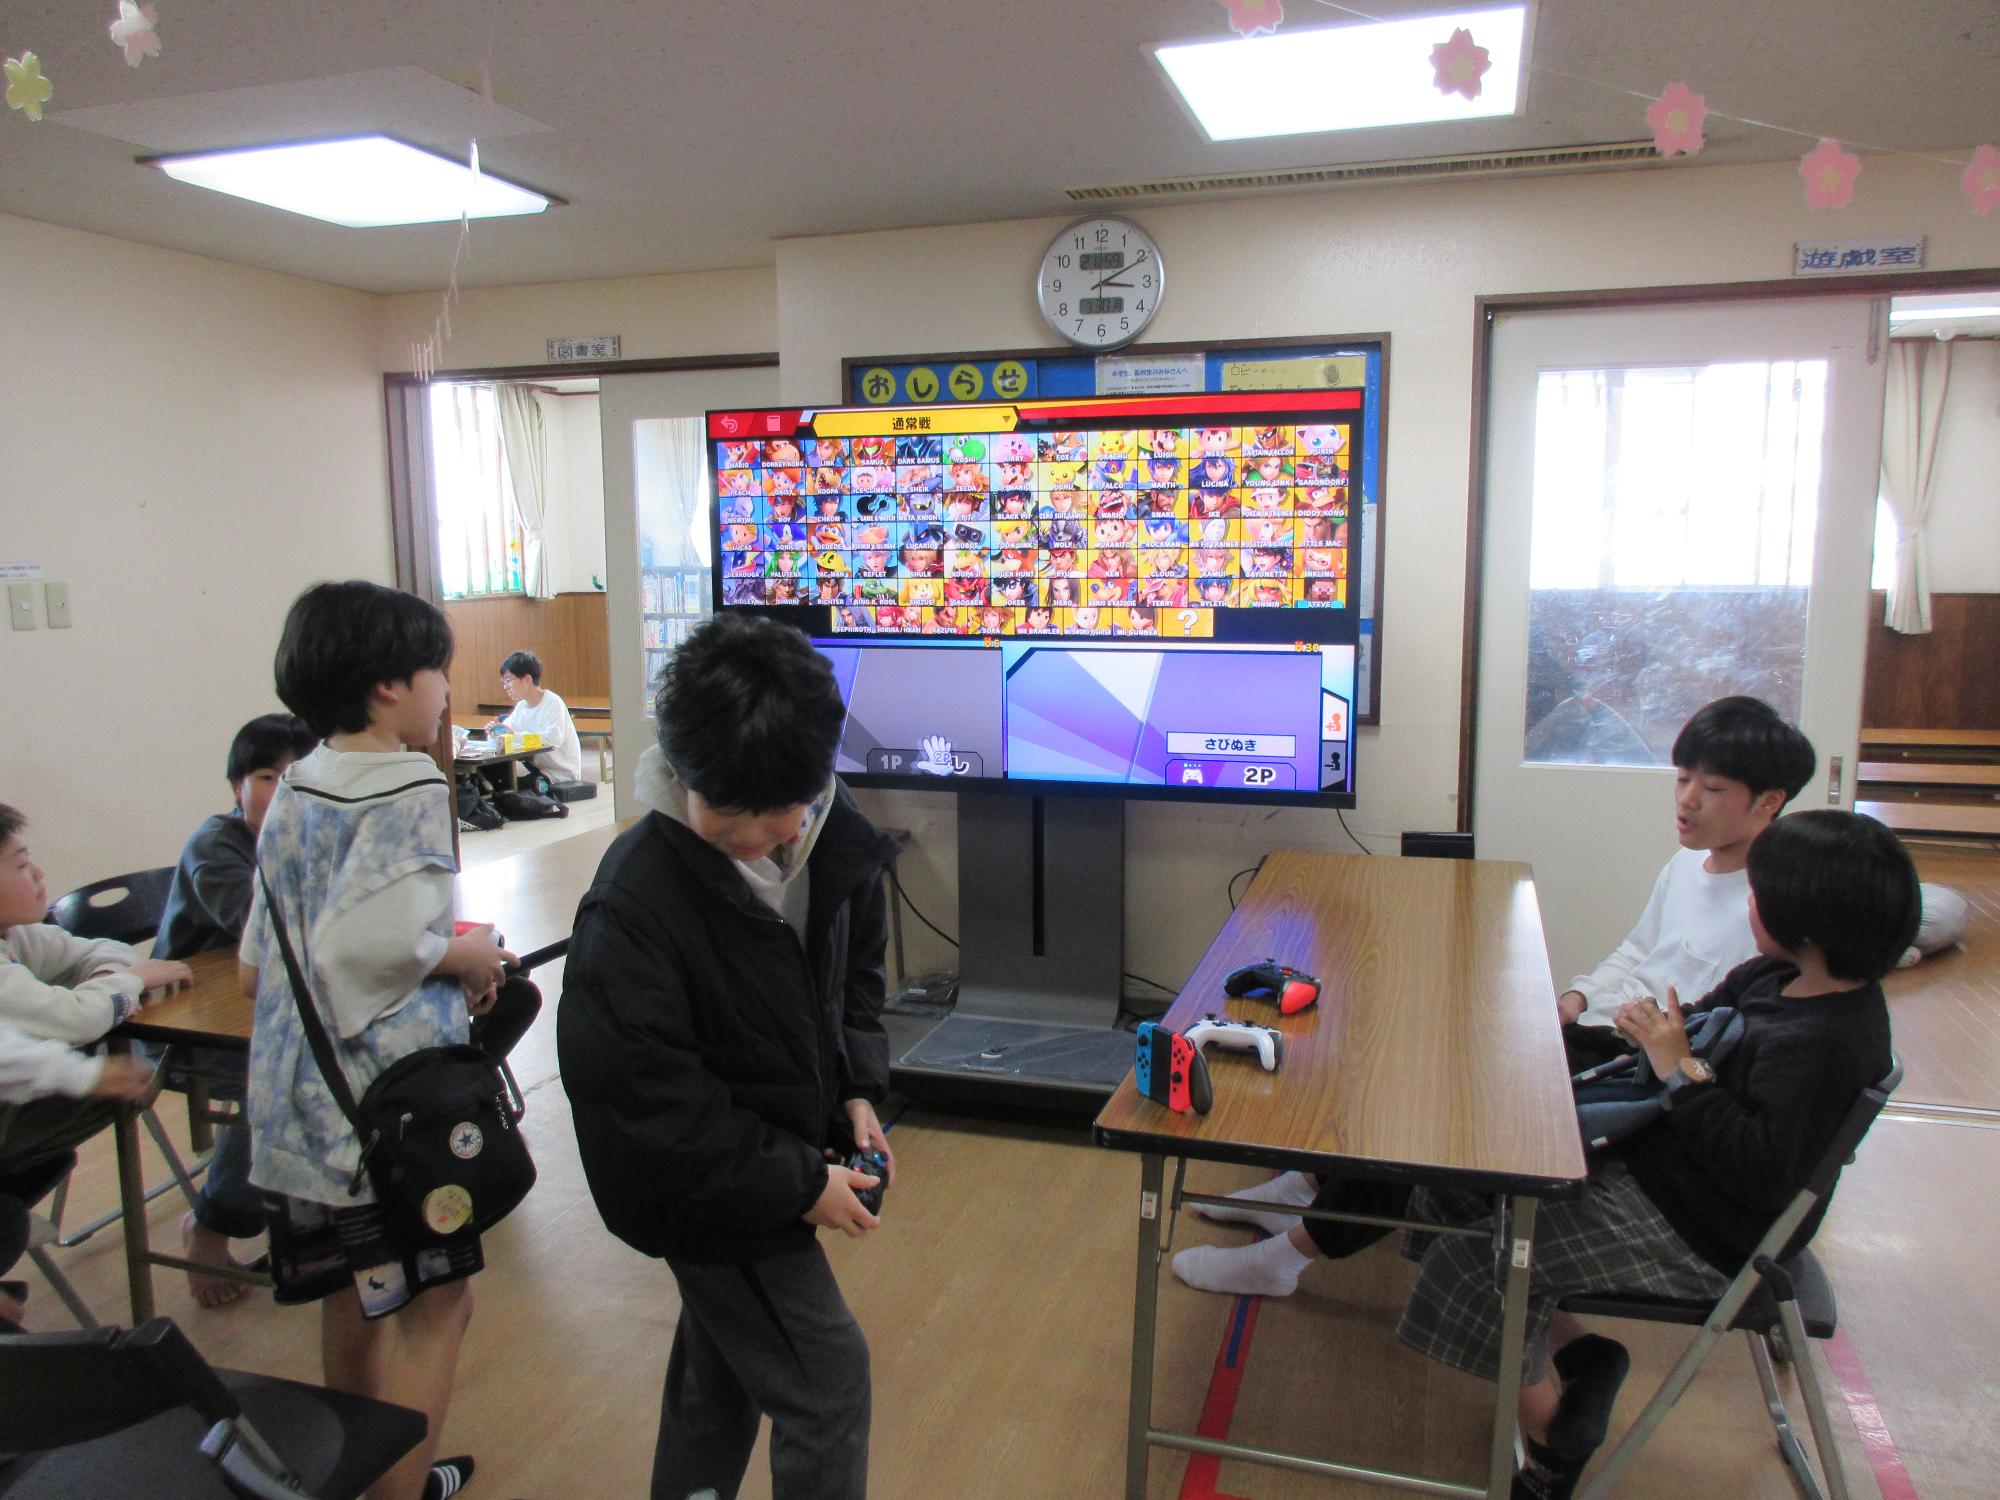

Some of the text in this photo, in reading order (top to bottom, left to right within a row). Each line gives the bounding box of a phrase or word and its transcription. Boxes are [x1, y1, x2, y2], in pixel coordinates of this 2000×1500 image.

[1096, 229, 1108, 242] 12
[1122, 234, 1126, 247] 1
[1075, 237, 1085, 249] 11
[1058, 255, 1070, 268] 10
[1136, 250, 1145, 262] 2
[1053, 280, 1062, 292] 9
[1142, 275, 1152, 288] 3
[1059, 304, 1068, 316] 8
[1136, 300, 1145, 312] 4
[1075, 319, 1083, 332] 7
[1120, 317, 1129, 329] 5
[1097, 324, 1106, 337] 6
[867, 368, 1020, 399] おしらせ
[892, 416, 931, 431] 通常戦
[1205, 738, 1257, 752] さびぬき
[880, 754, 903, 770] 1P
[934, 751, 951, 765] 2P
[1244, 767, 1275, 784] 2P
